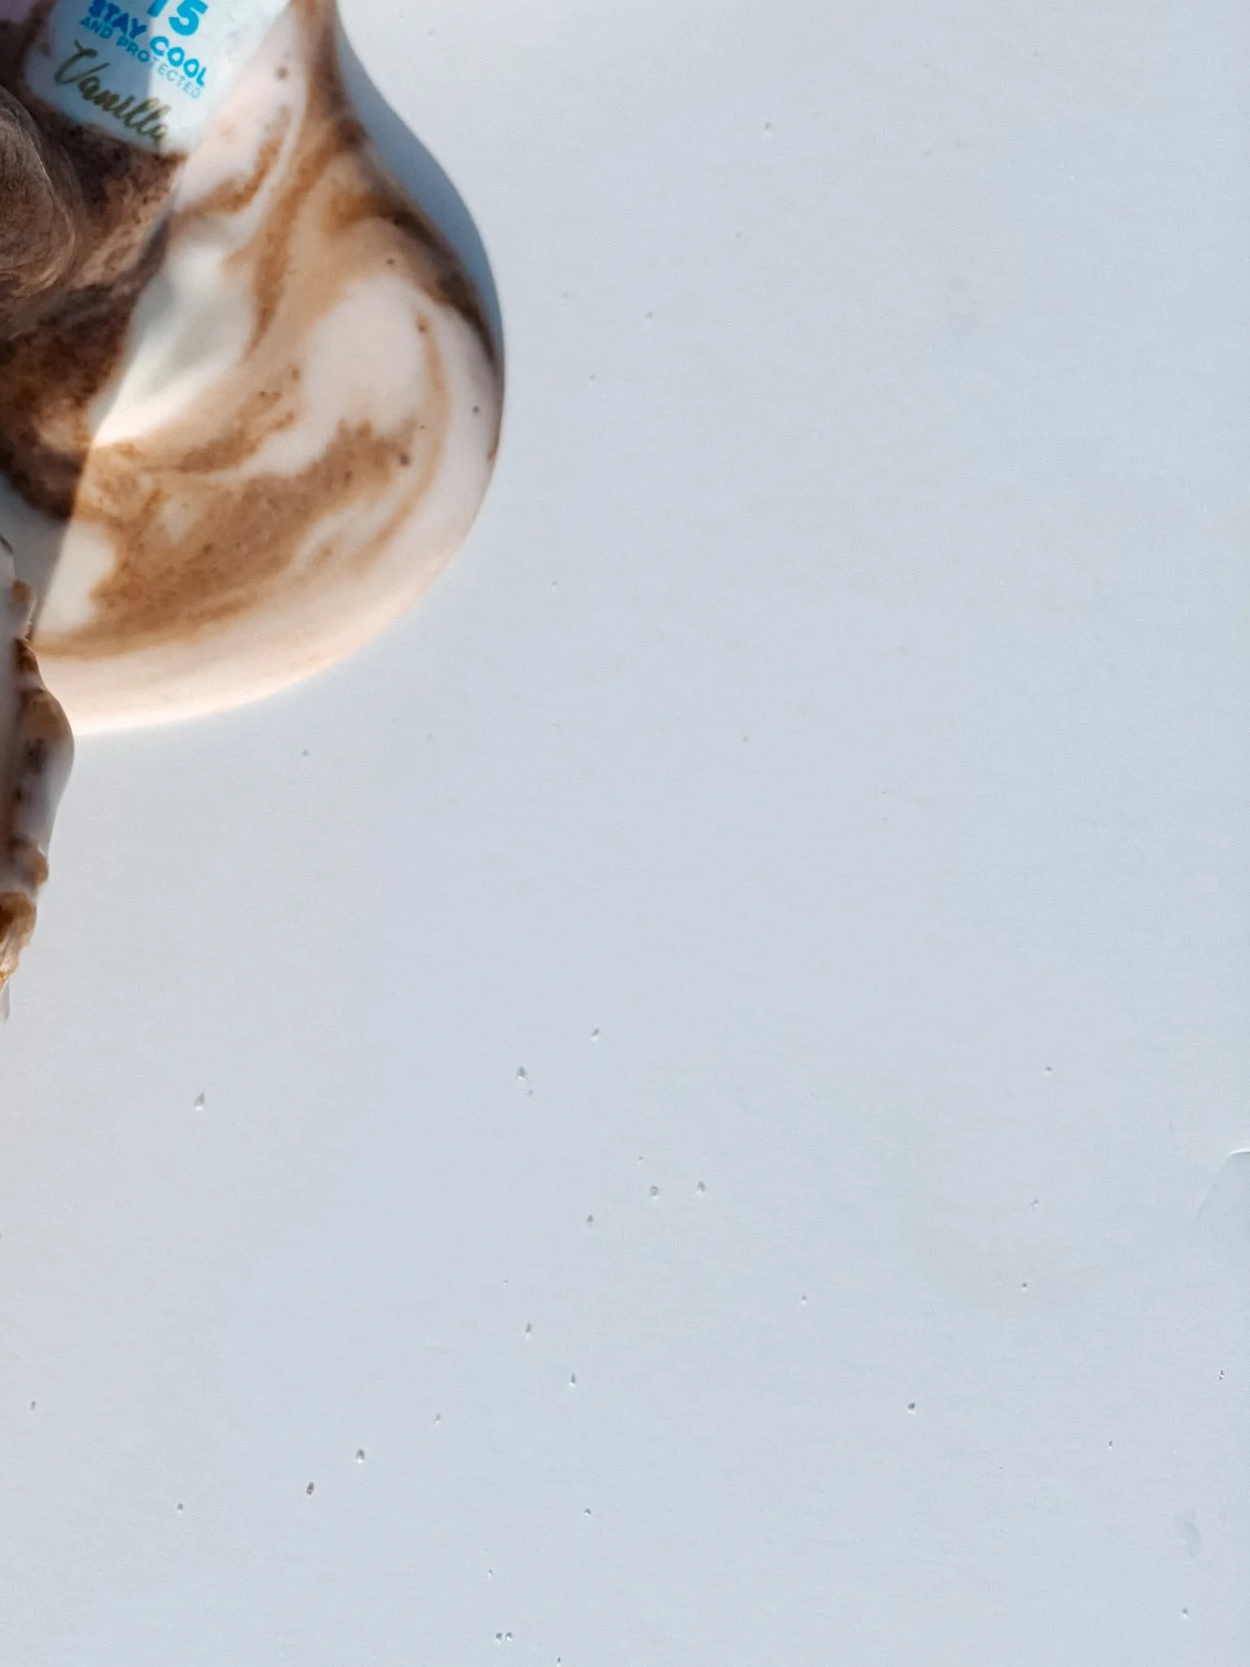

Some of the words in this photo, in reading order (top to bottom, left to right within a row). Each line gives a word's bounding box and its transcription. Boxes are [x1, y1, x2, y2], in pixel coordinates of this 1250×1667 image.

[79, 16, 114, 40] AND
[115, 34, 202, 100] PROTECTED
[149, 35, 207, 88] COOL
